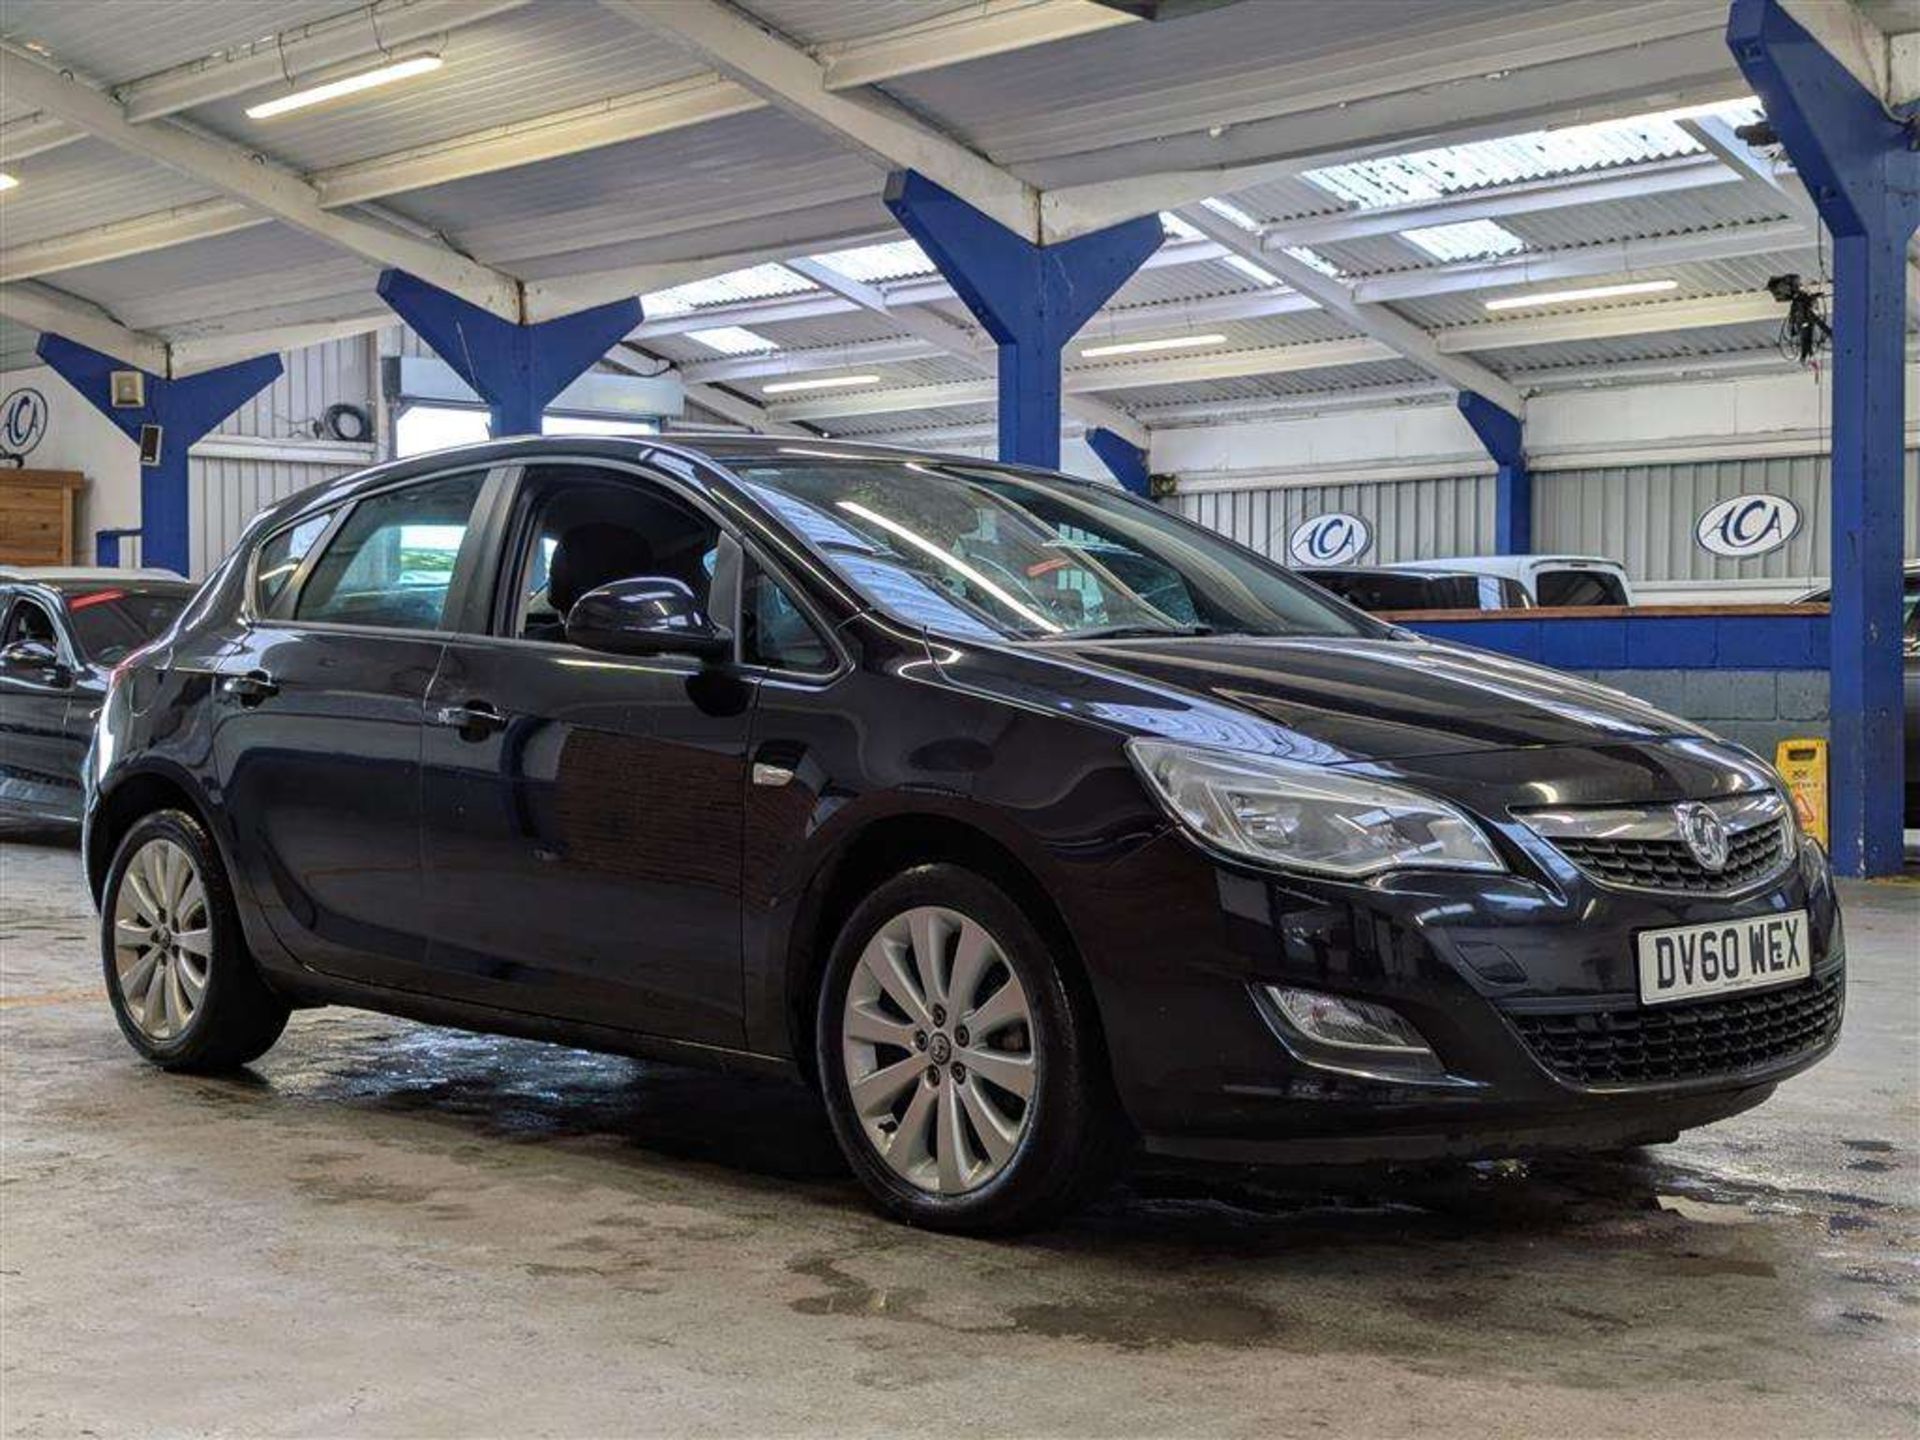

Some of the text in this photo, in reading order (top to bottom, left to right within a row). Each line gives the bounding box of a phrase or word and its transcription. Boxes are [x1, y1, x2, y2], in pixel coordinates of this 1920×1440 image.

[1294, 518, 1355, 560] ACA
[1703, 500, 1782, 548] ACA
[1655, 918, 1801, 990] DV60 WEX
